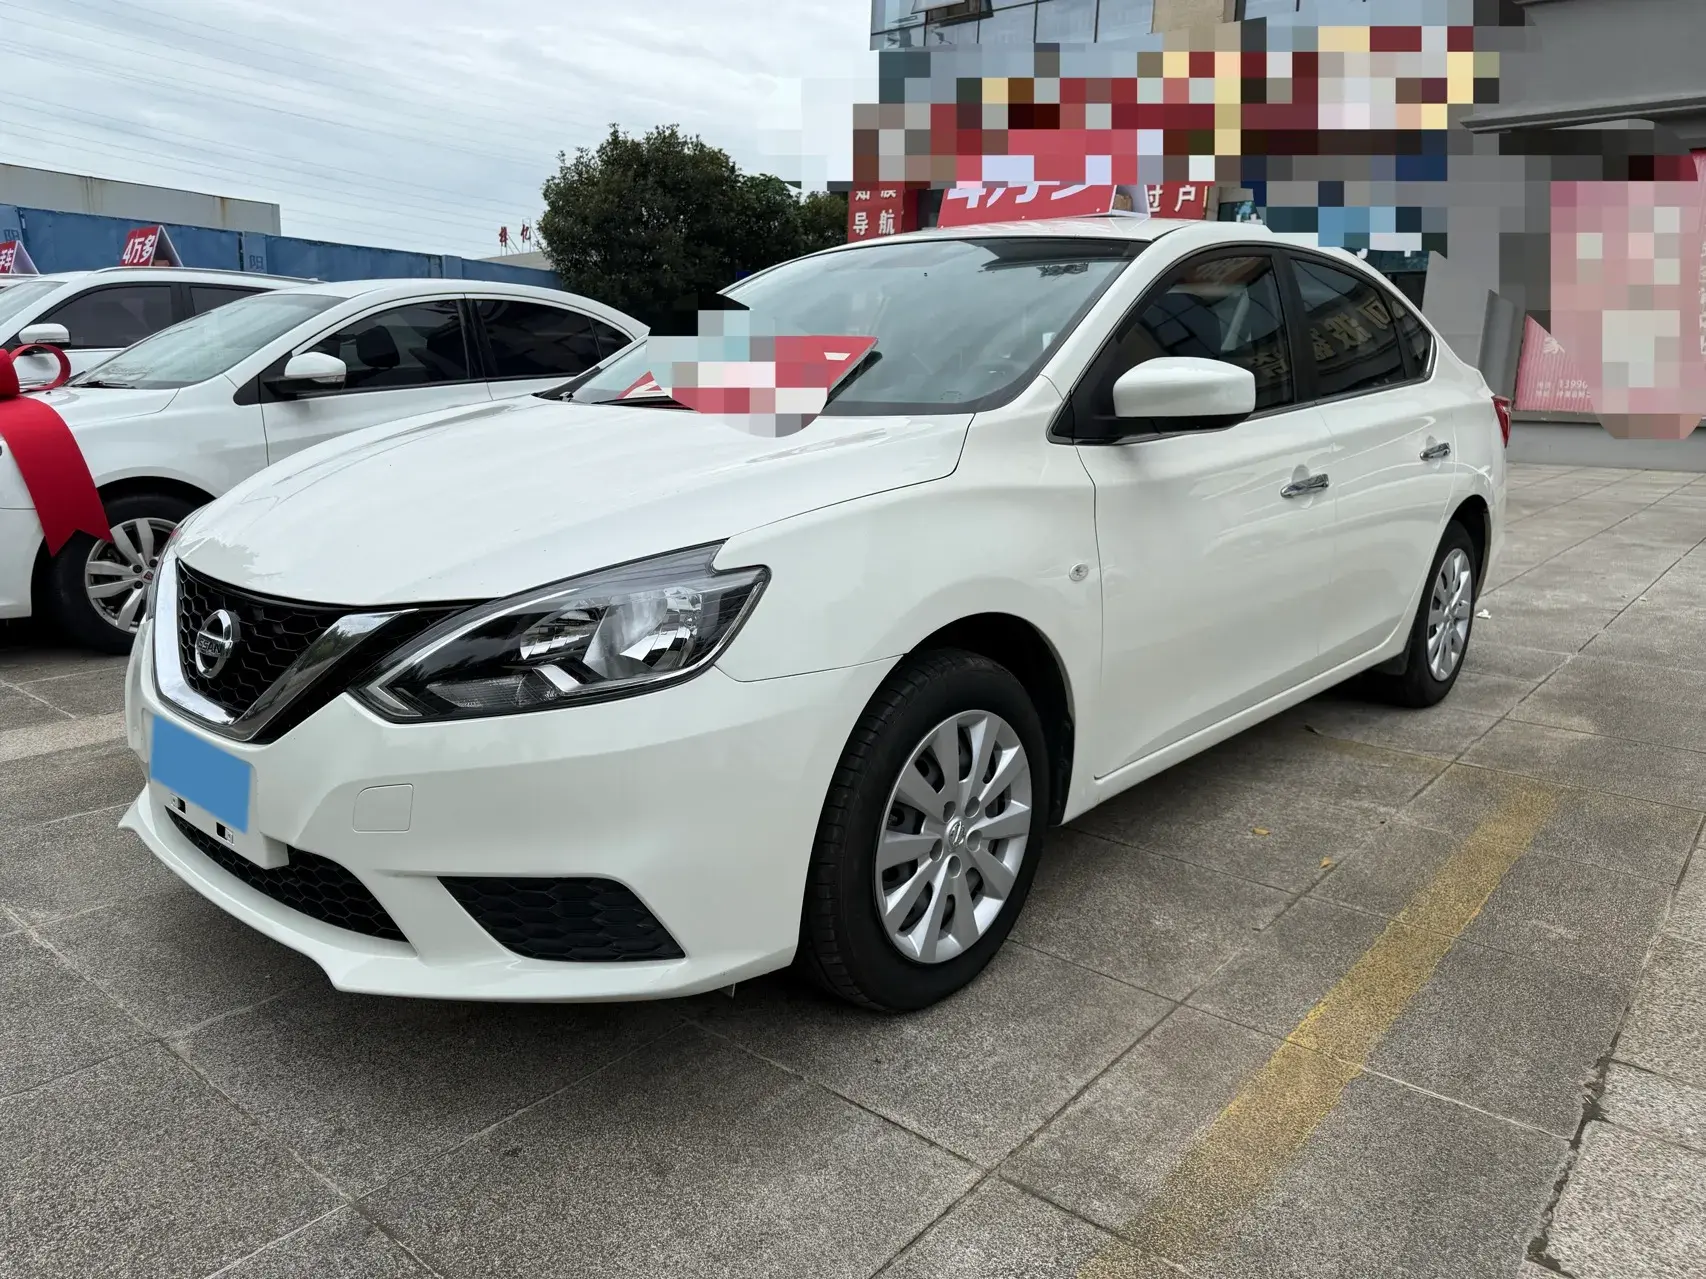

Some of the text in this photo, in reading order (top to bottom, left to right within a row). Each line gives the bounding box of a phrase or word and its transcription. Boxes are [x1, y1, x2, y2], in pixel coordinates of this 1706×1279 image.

[1149, 185, 1196, 212] 过户
[853, 209, 895, 236] 导航
[122, 234, 155, 265] 4万多
